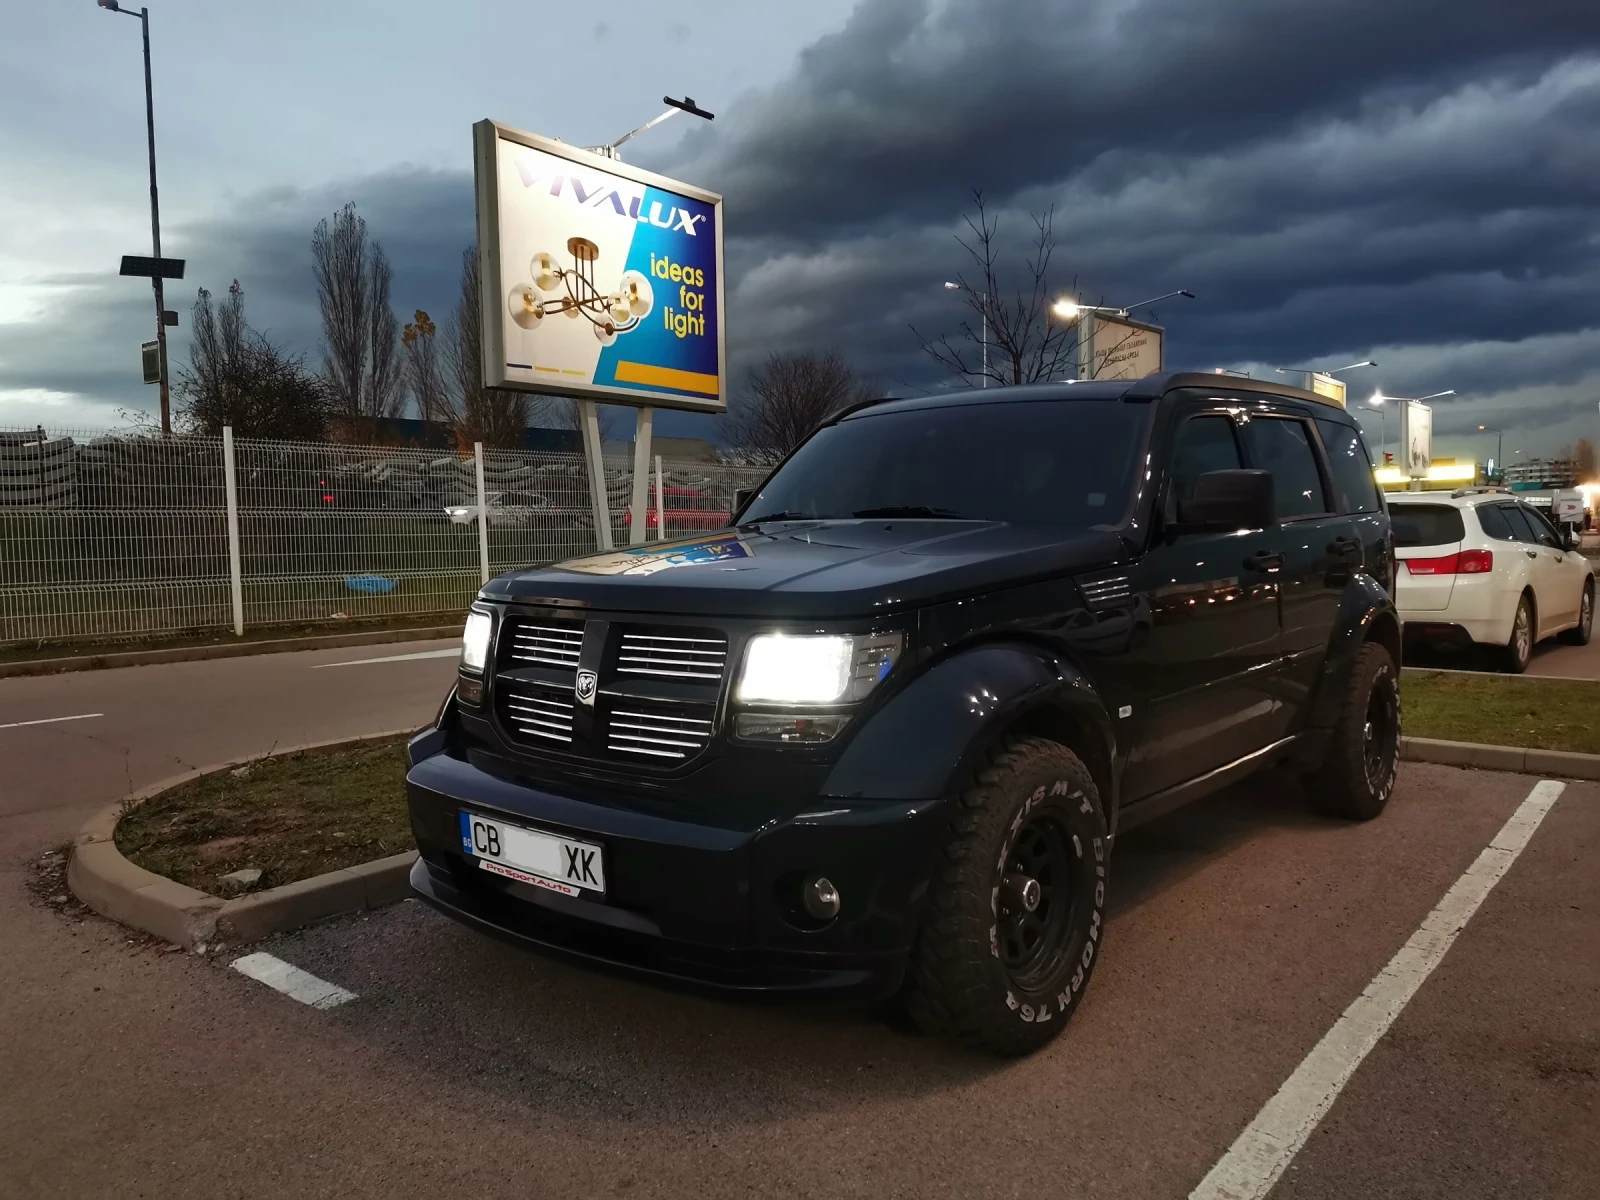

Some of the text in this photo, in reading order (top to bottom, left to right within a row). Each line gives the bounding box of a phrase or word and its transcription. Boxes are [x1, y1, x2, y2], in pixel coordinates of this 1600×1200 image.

[513, 159, 702, 237] VIVALUX
[650, 252, 704, 288] ideas
[680, 285, 705, 312] for
[664, 305, 706, 339] light
[463, 836, 472, 848] BG
[473, 821, 599, 886] CB XK
